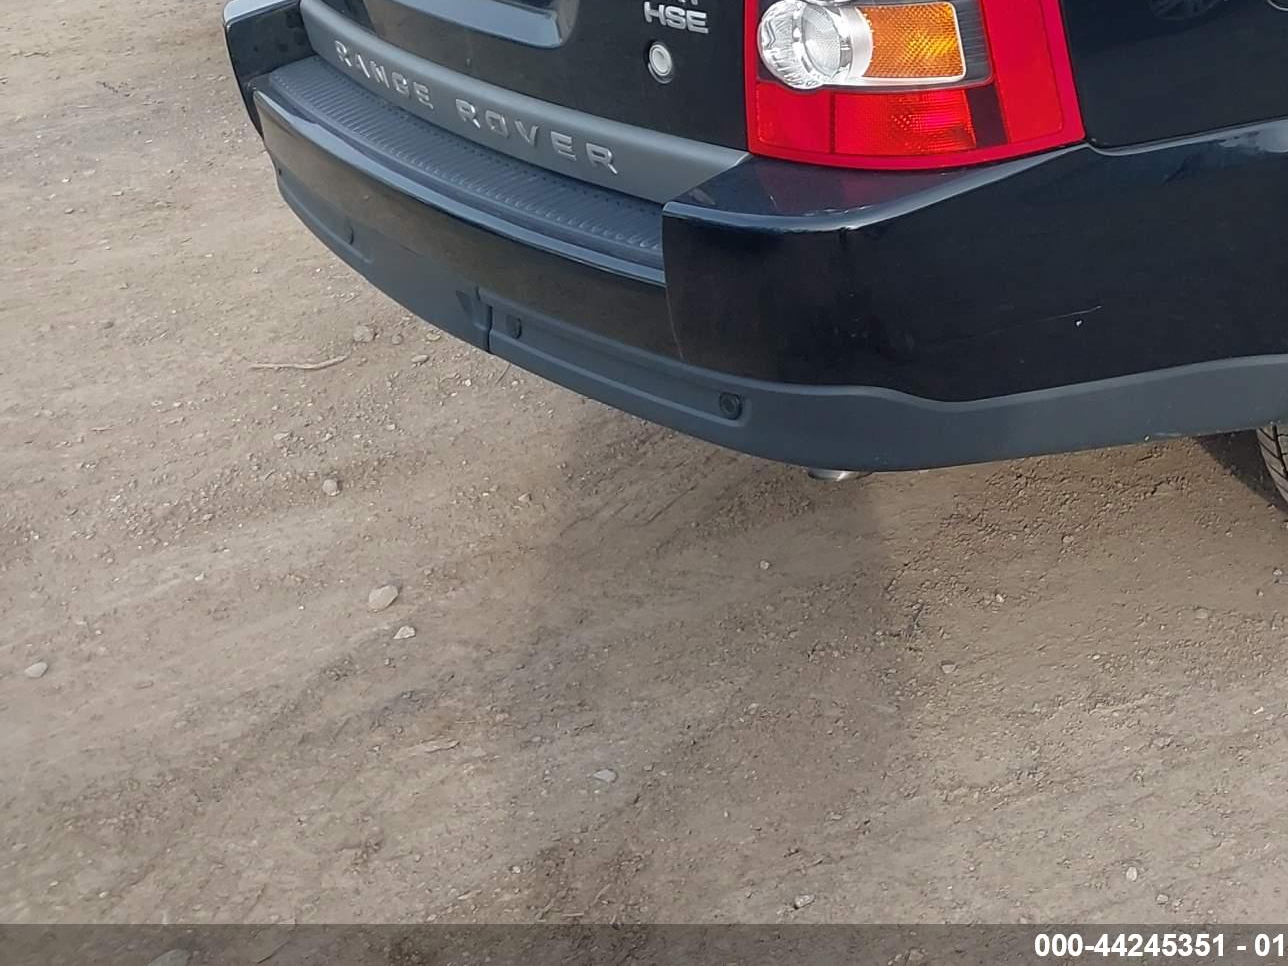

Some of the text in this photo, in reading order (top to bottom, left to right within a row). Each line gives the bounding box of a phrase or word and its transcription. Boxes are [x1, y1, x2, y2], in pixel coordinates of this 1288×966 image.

[644, 1, 709, 34] HSE
[334, 40, 618, 175] RANGE ROVER
